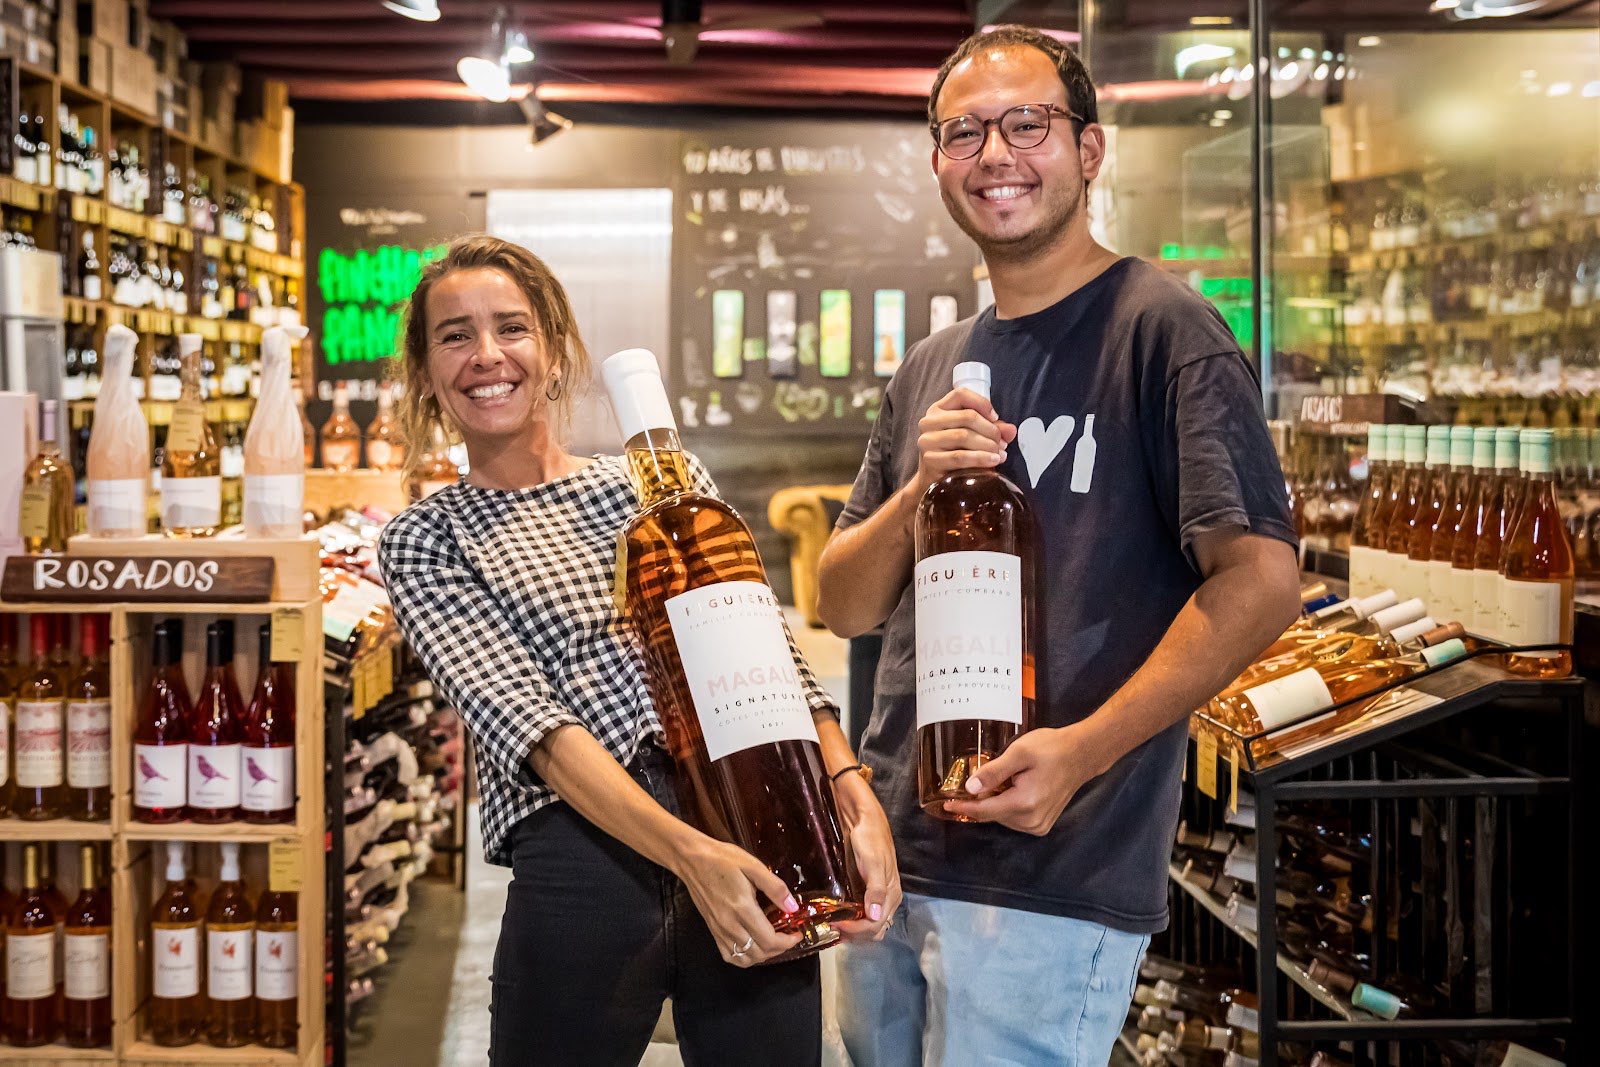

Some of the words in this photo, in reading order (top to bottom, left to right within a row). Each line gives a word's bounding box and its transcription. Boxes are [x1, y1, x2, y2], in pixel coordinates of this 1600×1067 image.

[33, 559, 219, 592] ROSADOS
[917, 635, 1011, 664] MAGALI
[706, 665, 797, 697] MAGALI
